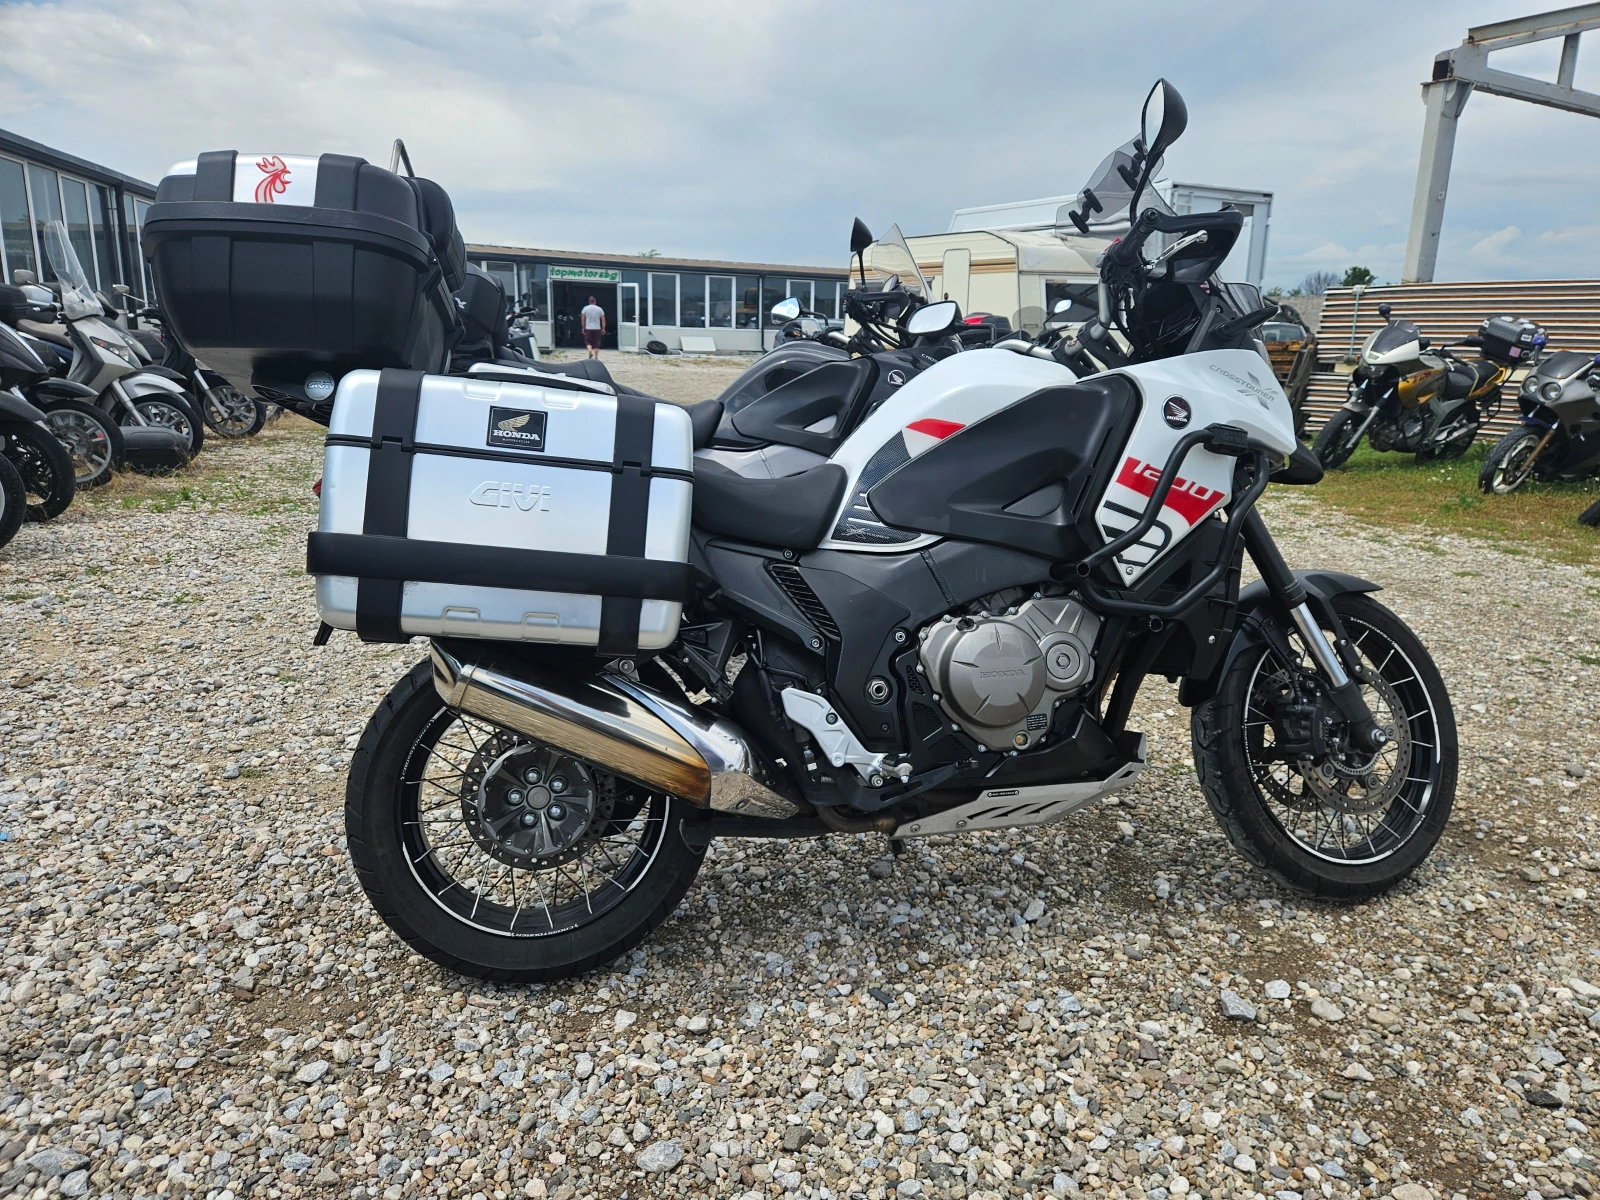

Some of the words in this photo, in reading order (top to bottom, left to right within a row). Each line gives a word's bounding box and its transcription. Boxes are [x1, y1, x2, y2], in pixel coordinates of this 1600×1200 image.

[550, 266, 618, 281] topmotorsbg
[1208, 364, 1276, 402] CROSSTOURER
[1166, 415, 1188, 423] HONDA
[492, 429, 541, 441] HONDA
[468, 480, 552, 512] GIVI
[979, 669, 1026, 679] HONDA
